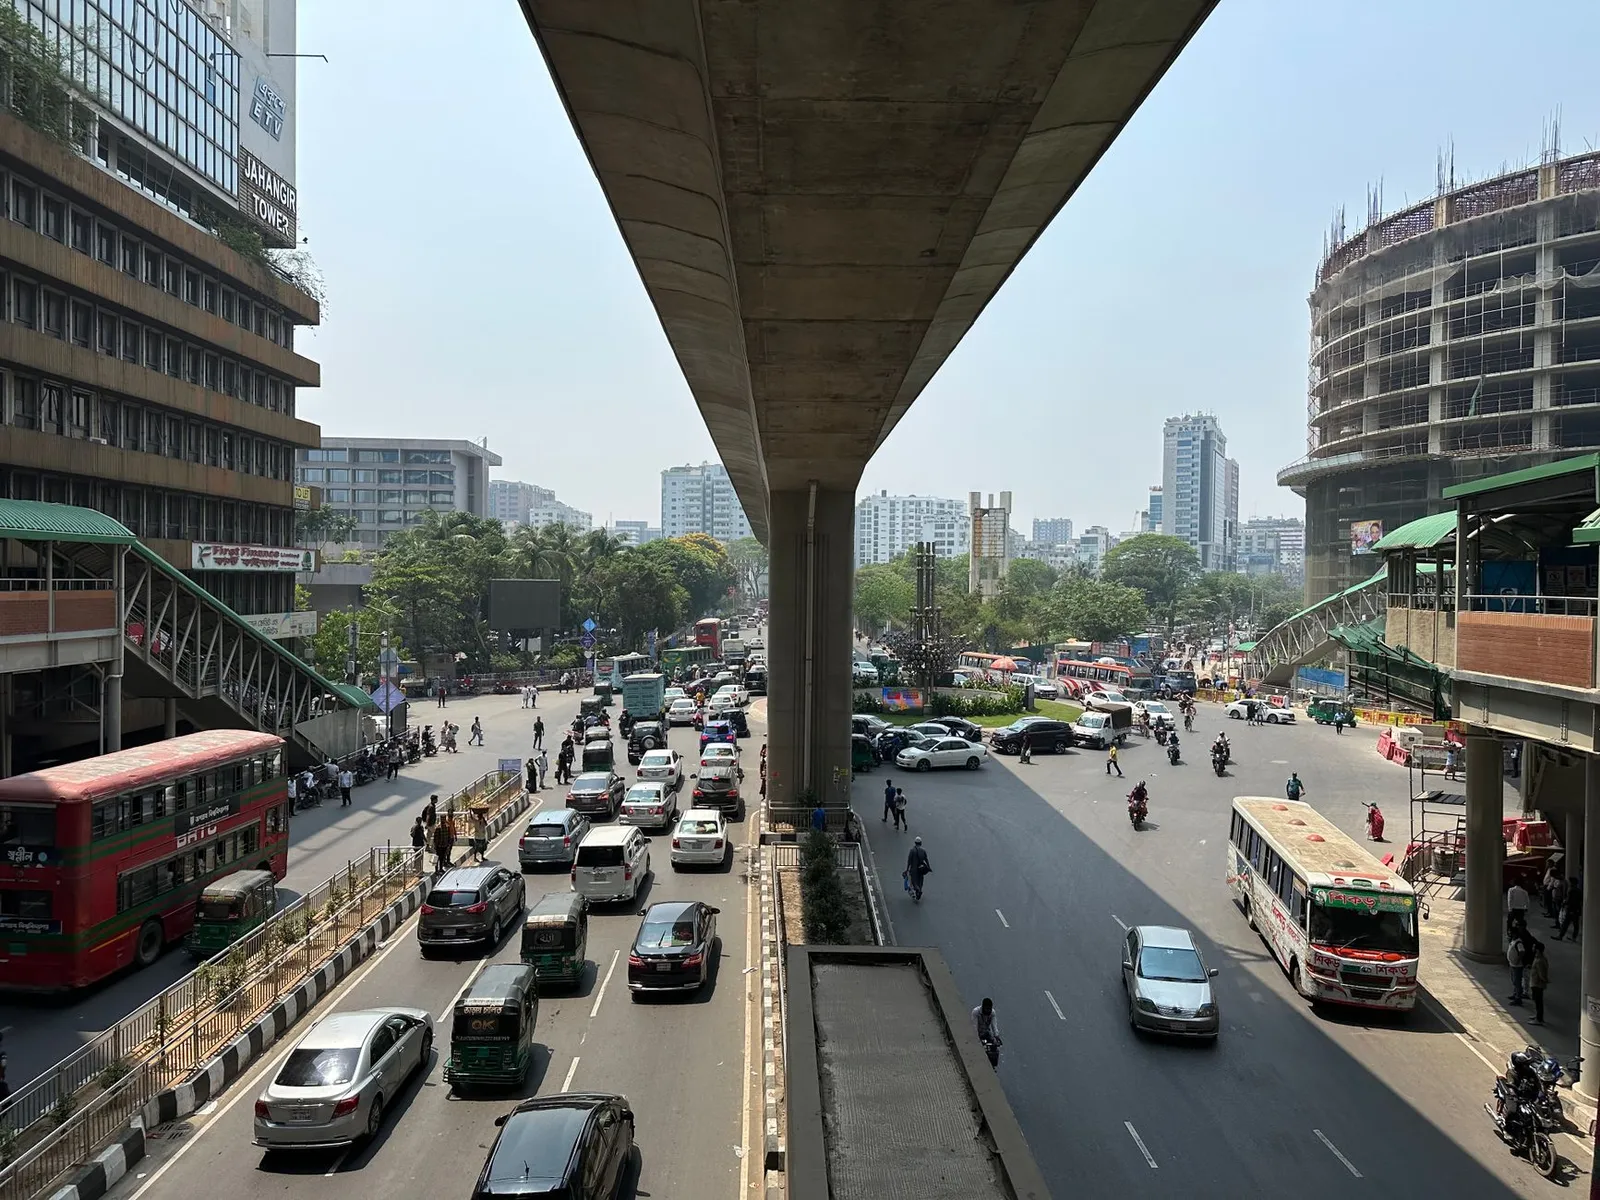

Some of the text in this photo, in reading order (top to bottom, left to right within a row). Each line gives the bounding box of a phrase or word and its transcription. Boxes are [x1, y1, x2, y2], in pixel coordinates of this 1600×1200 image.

[253, 101, 281, 134] ETV
[244, 155, 296, 213] JAHANGIR
[252, 192, 289, 237] TOWER
[471, 1020, 496, 1030] OK
